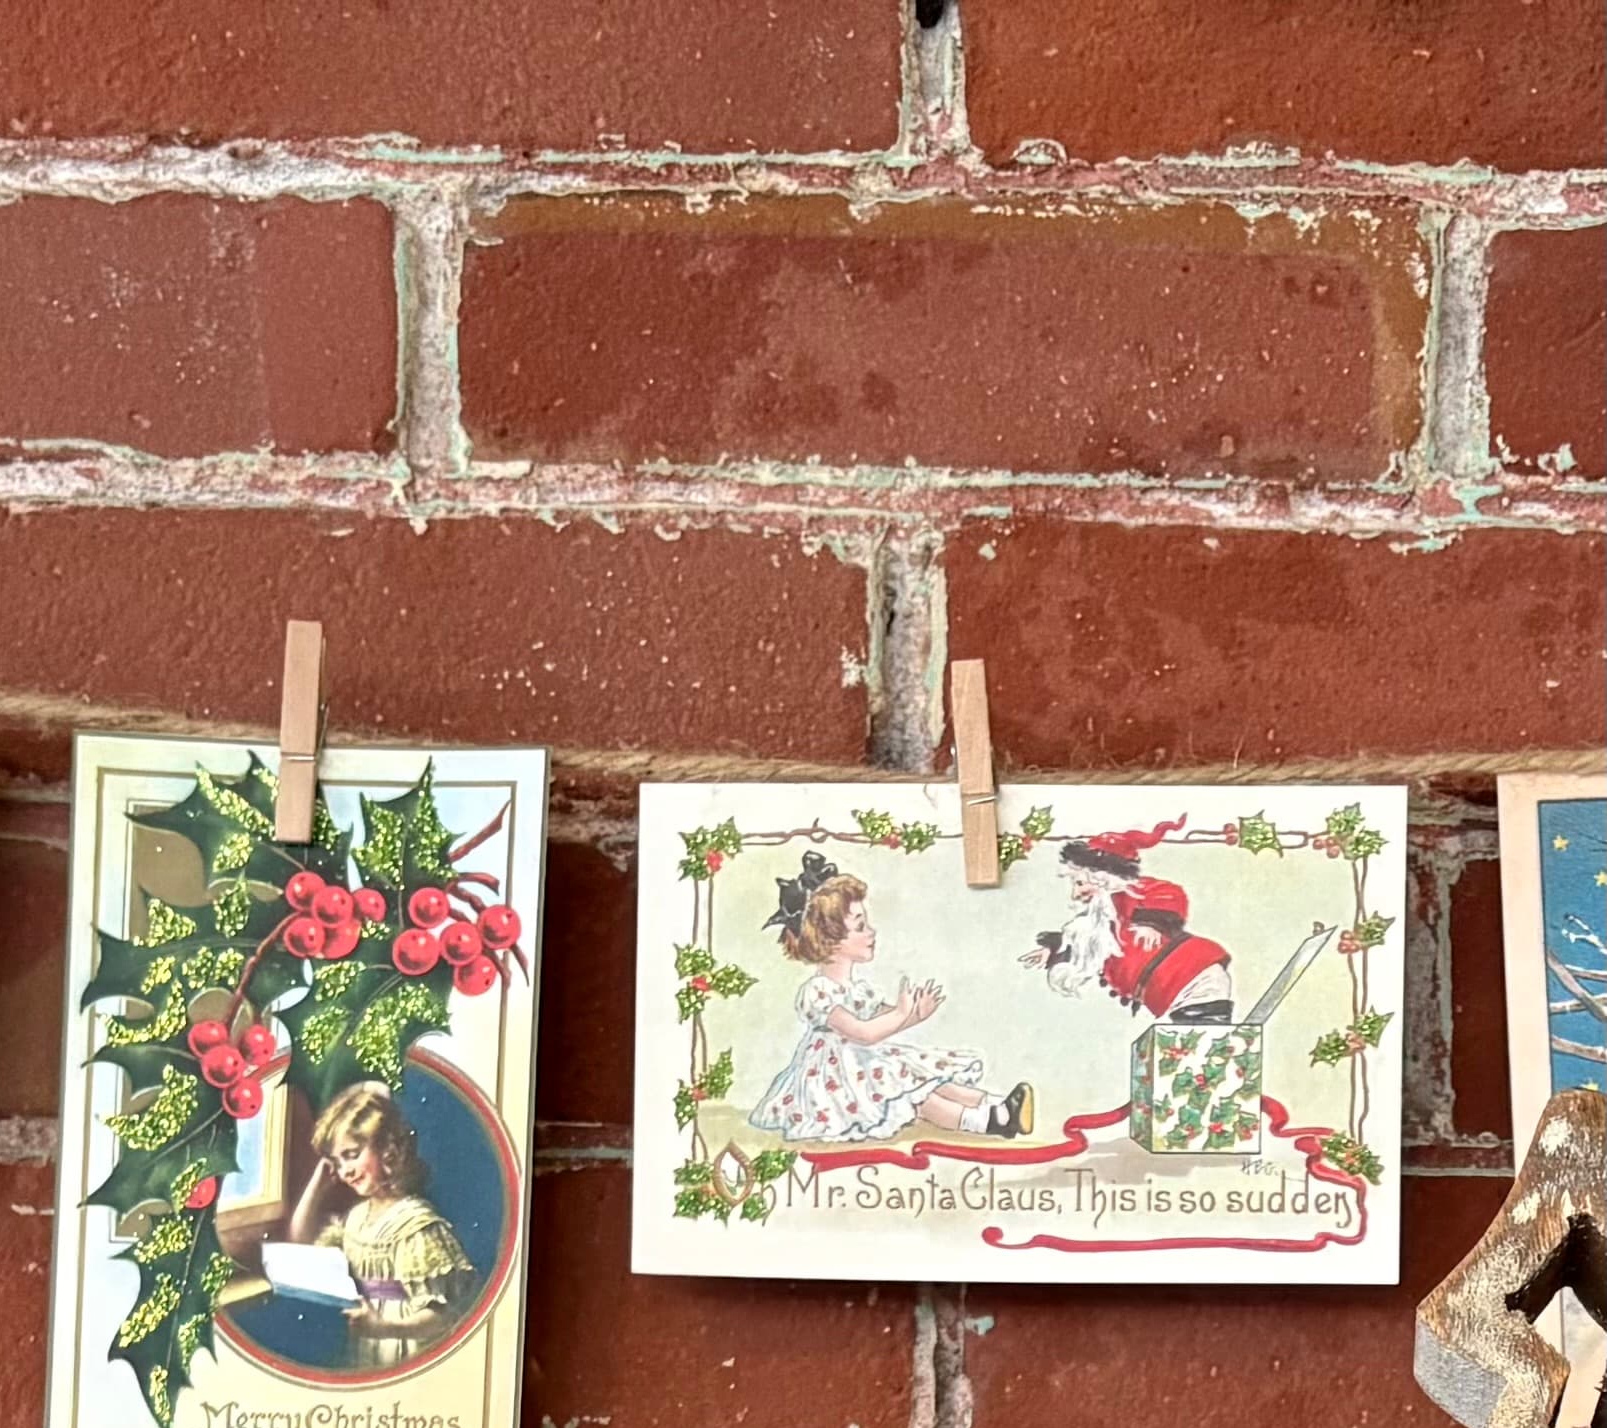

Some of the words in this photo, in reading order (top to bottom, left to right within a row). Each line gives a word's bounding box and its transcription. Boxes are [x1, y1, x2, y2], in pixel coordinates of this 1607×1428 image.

[786, 1162, 848, 1209] Mr.
[855, 1164, 958, 1218] Santa
[960, 1166, 1062, 1215] Claus,
[1064, 1167, 1137, 1229] This
[1146, 1178, 1172, 1214] is
[1178, 1189, 1217, 1214] so
[1226, 1168, 1353, 1229] sudden
